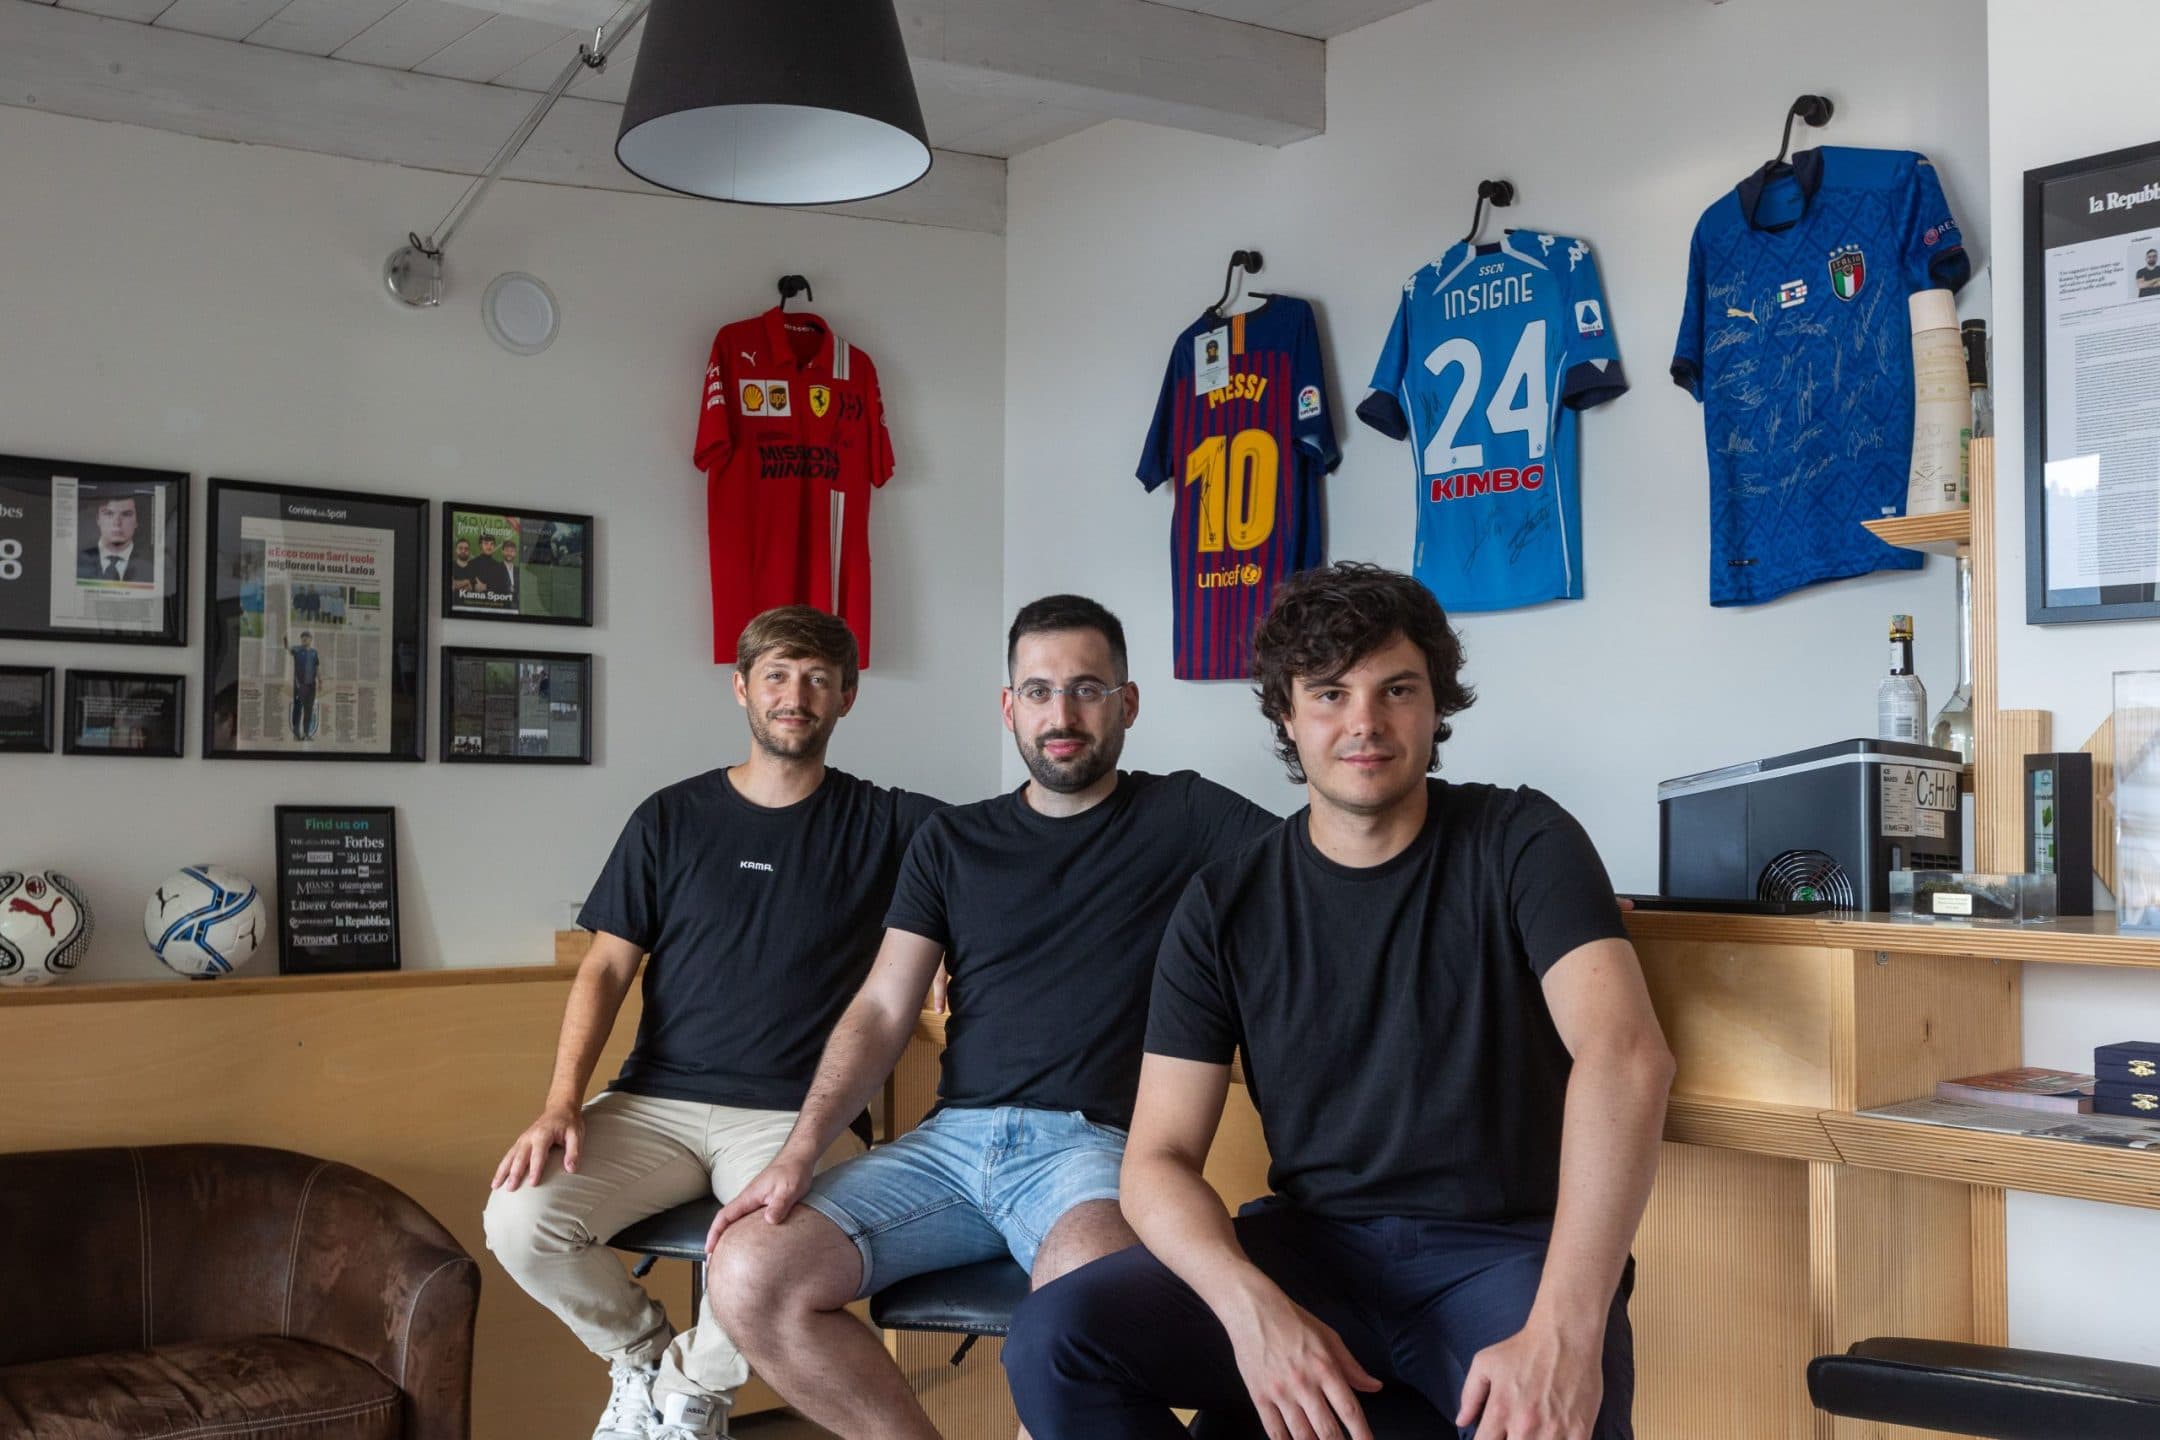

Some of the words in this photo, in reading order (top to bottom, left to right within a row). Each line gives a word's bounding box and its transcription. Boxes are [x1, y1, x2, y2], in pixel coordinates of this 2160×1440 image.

[2088, 196, 2104, 214] la
[1478, 263, 1505, 277] SSCN
[1444, 272, 1533, 321] INSIGNE
[1206, 372, 1268, 409] MESSI
[1424, 319, 1549, 476] 24
[1185, 428, 1279, 552] 10
[1430, 463, 1545, 503] KIMBO
[288, 505, 317, 517] Corriere
[327, 509, 347, 520] Sport
[299, 550, 325, 561] come
[351, 553, 375, 564] vuole
[317, 562, 325, 572] la
[1198, 563, 1241, 588] unicef
[305, 818, 333, 830] Find
[336, 820, 350, 830] us
[352, 819, 369, 830] on
[344, 836, 385, 849] Forbes
[291, 900, 327, 911] Libero
[330, 900, 359, 910] Corriere
[368, 900, 388, 911] Sport
[335, 915, 344, 927] la
[345, 915, 391, 929] Repubblica
